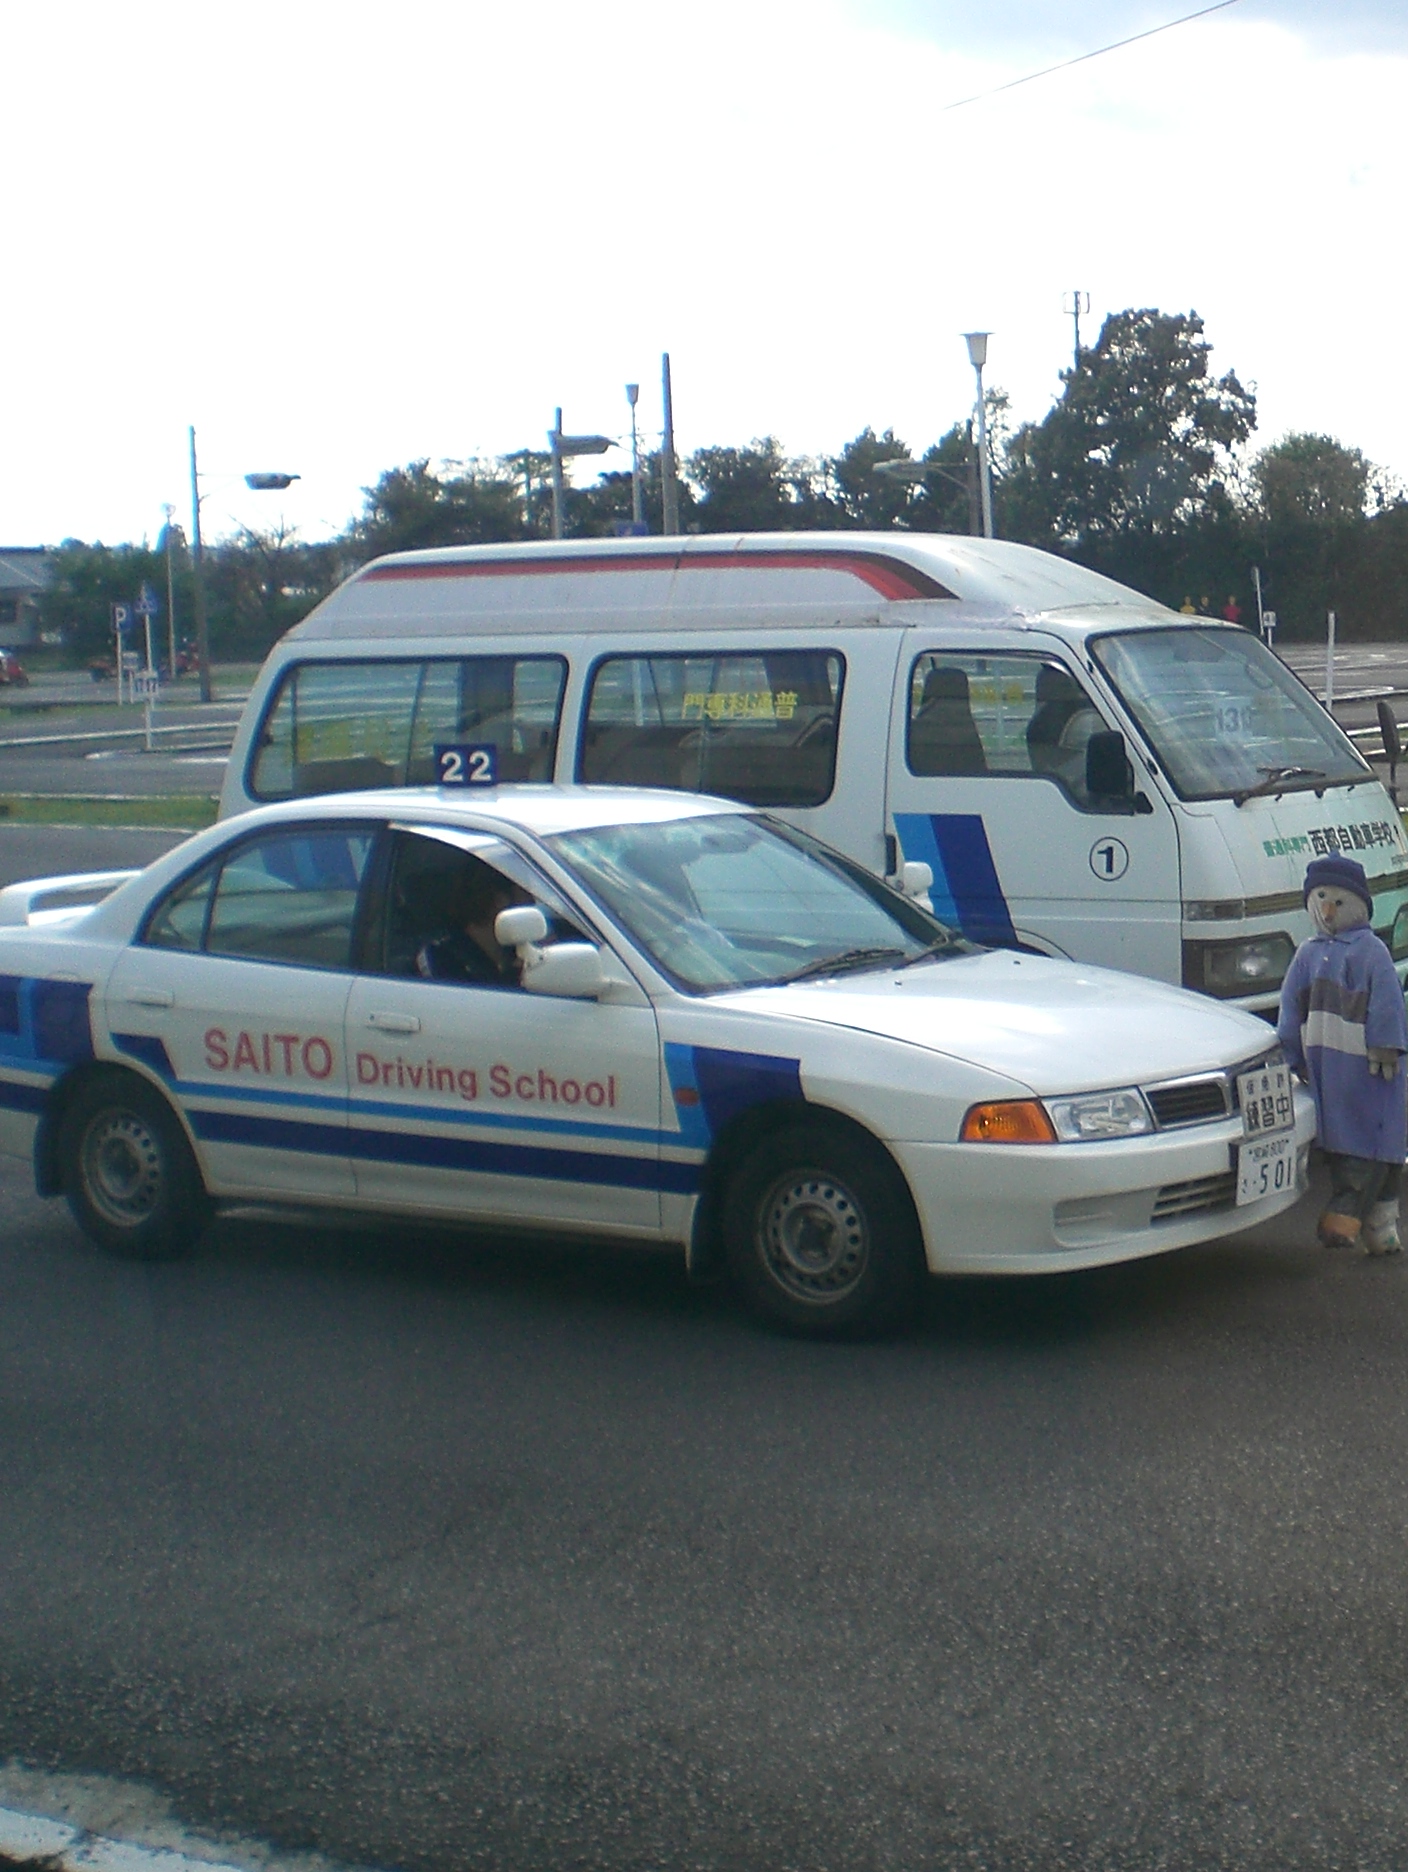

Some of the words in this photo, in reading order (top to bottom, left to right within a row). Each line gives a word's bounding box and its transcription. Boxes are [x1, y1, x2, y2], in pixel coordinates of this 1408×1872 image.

[440, 750, 493, 782] 22
[203, 1026, 334, 1081] SAITO
[355, 1052, 479, 1101] Driving
[488, 1064, 617, 1109] School
